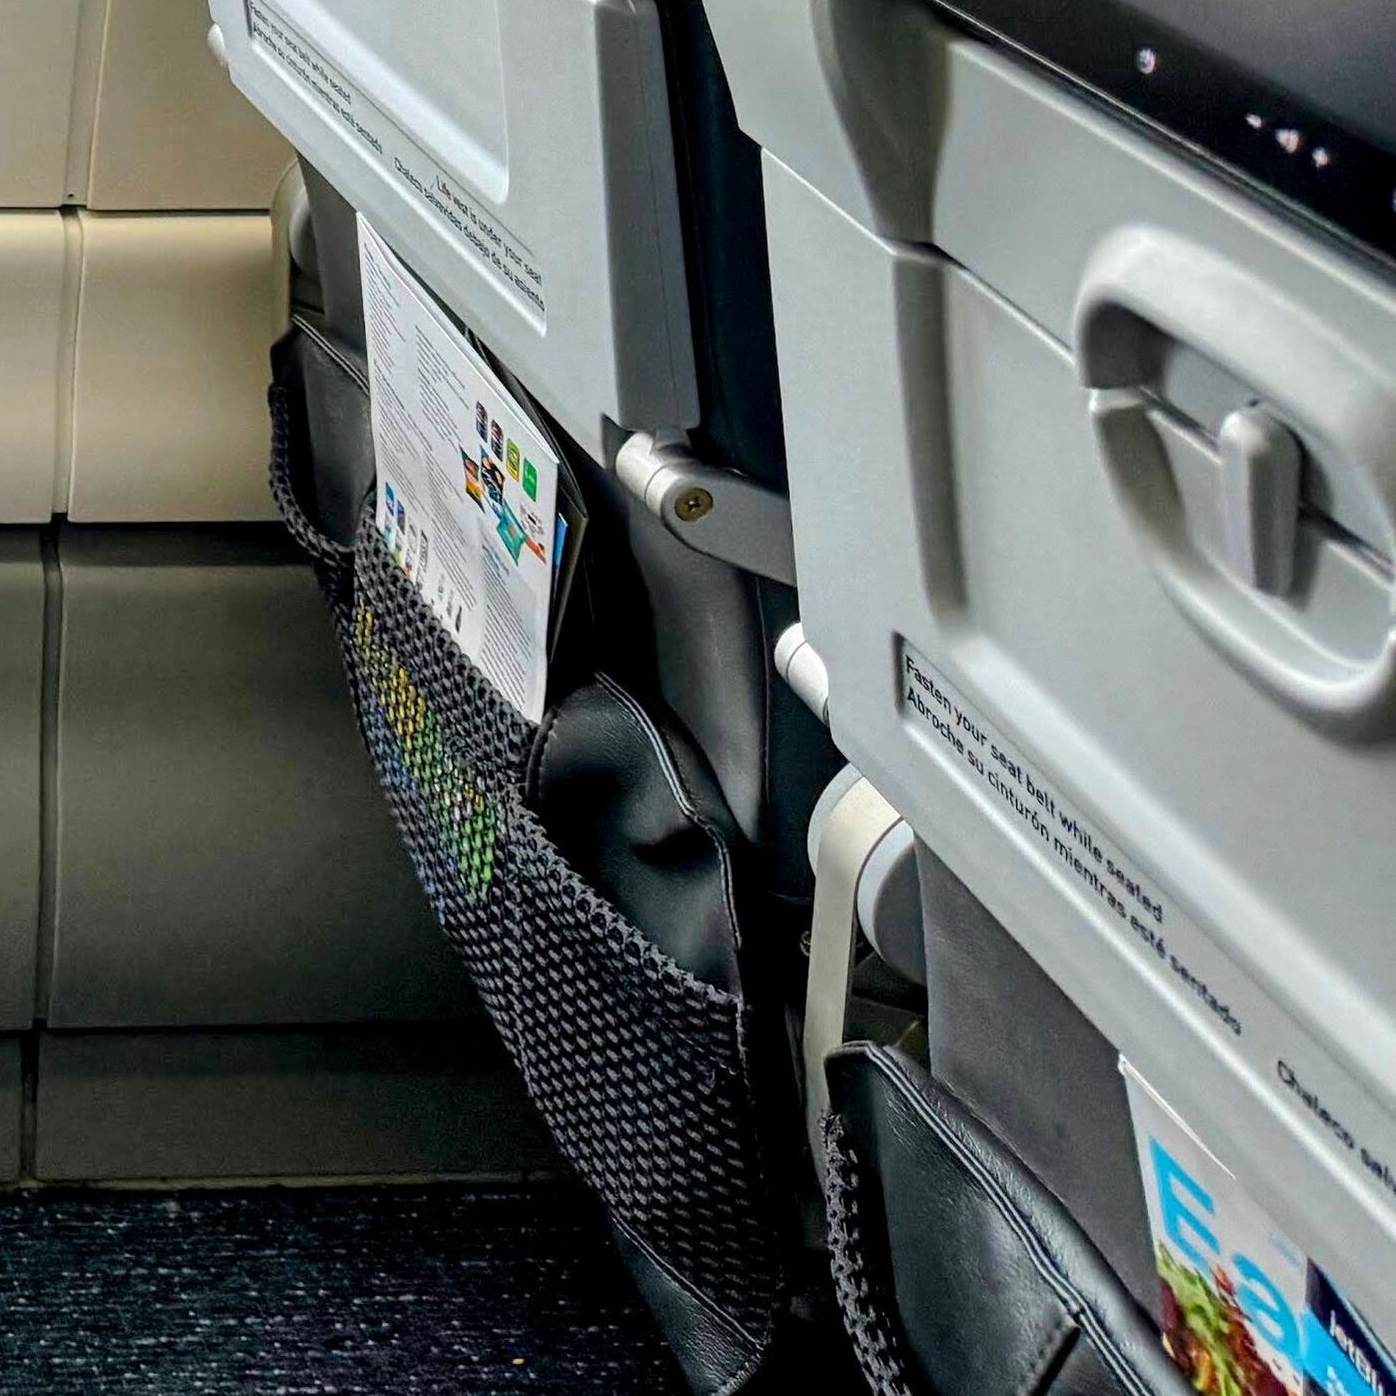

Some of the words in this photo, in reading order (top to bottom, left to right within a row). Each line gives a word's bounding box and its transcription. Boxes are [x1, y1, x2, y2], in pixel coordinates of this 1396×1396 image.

[906, 655, 952, 715] Fasten
[954, 706, 988, 746] your
[991, 744, 1022, 784] seat
[1026, 773, 1056, 819] belt
[1059, 811, 1103, 864] while
[1106, 859, 1163, 924] seated
[907, 686, 964, 756] Abroche
[967, 749, 984, 775] su
[988, 771, 1050, 842] cinturón
[1054, 837, 1127, 918] mientras
